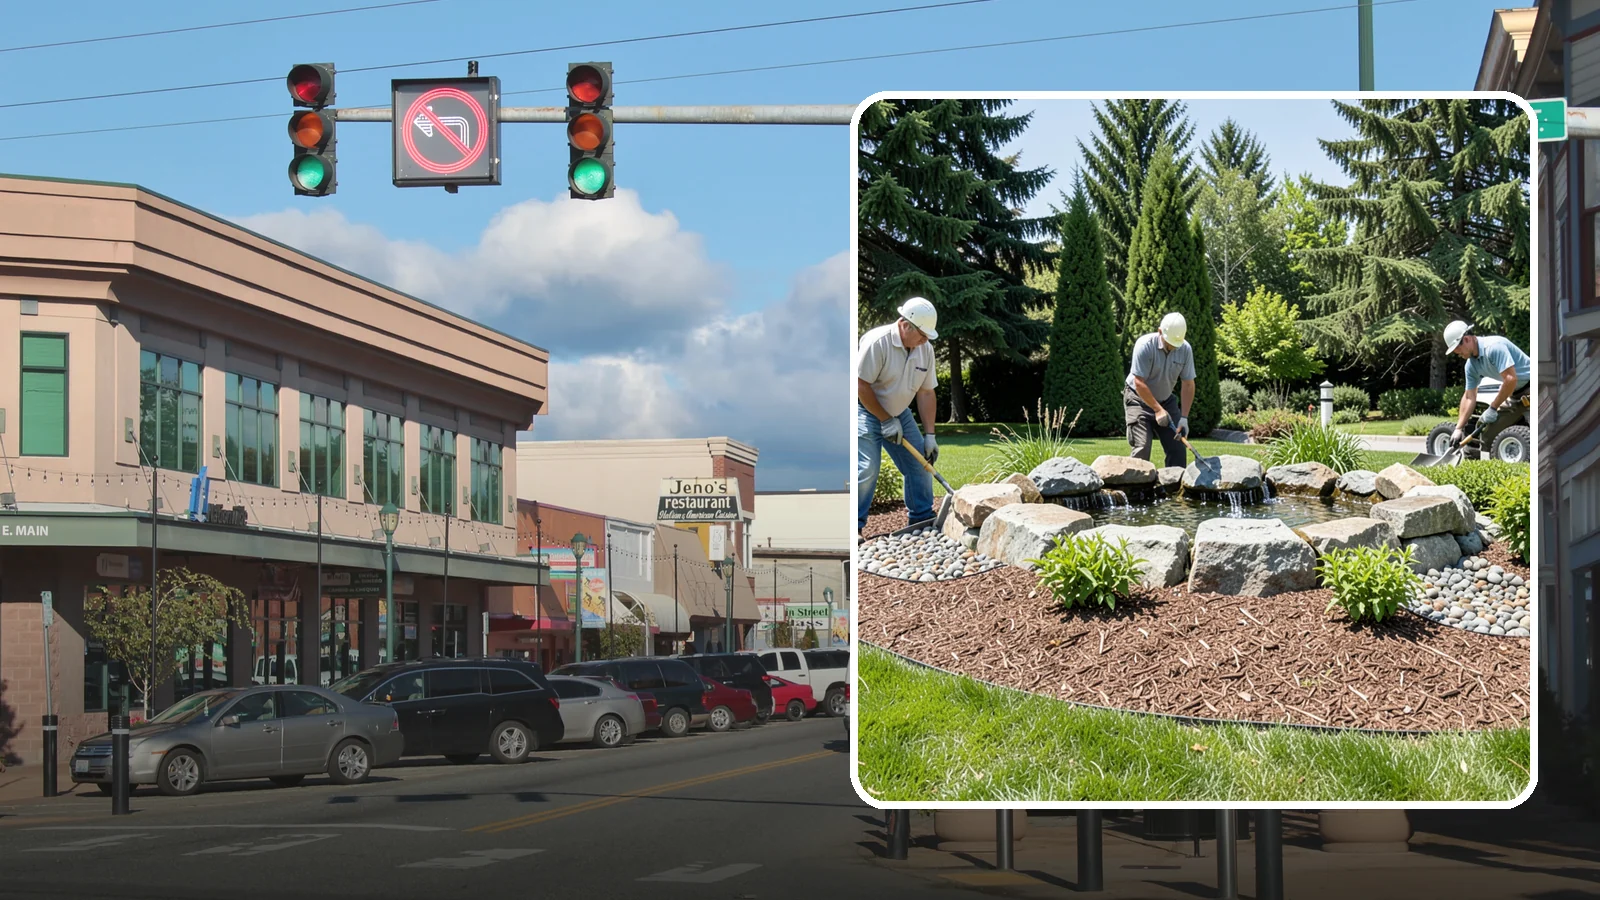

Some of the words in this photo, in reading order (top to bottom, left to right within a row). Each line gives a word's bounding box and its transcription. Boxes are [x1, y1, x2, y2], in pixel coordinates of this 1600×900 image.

[670, 480, 727, 494] Jeno's
[665, 496, 731, 509] restaurant
[659, 510, 681, 519] Italian
[686, 510, 714, 519] American
[715, 510, 737, 519] Cuisine
[2, 525, 13, 536] E.
[16, 526, 48, 536] MAIN
[798, 607, 828, 617] Street
